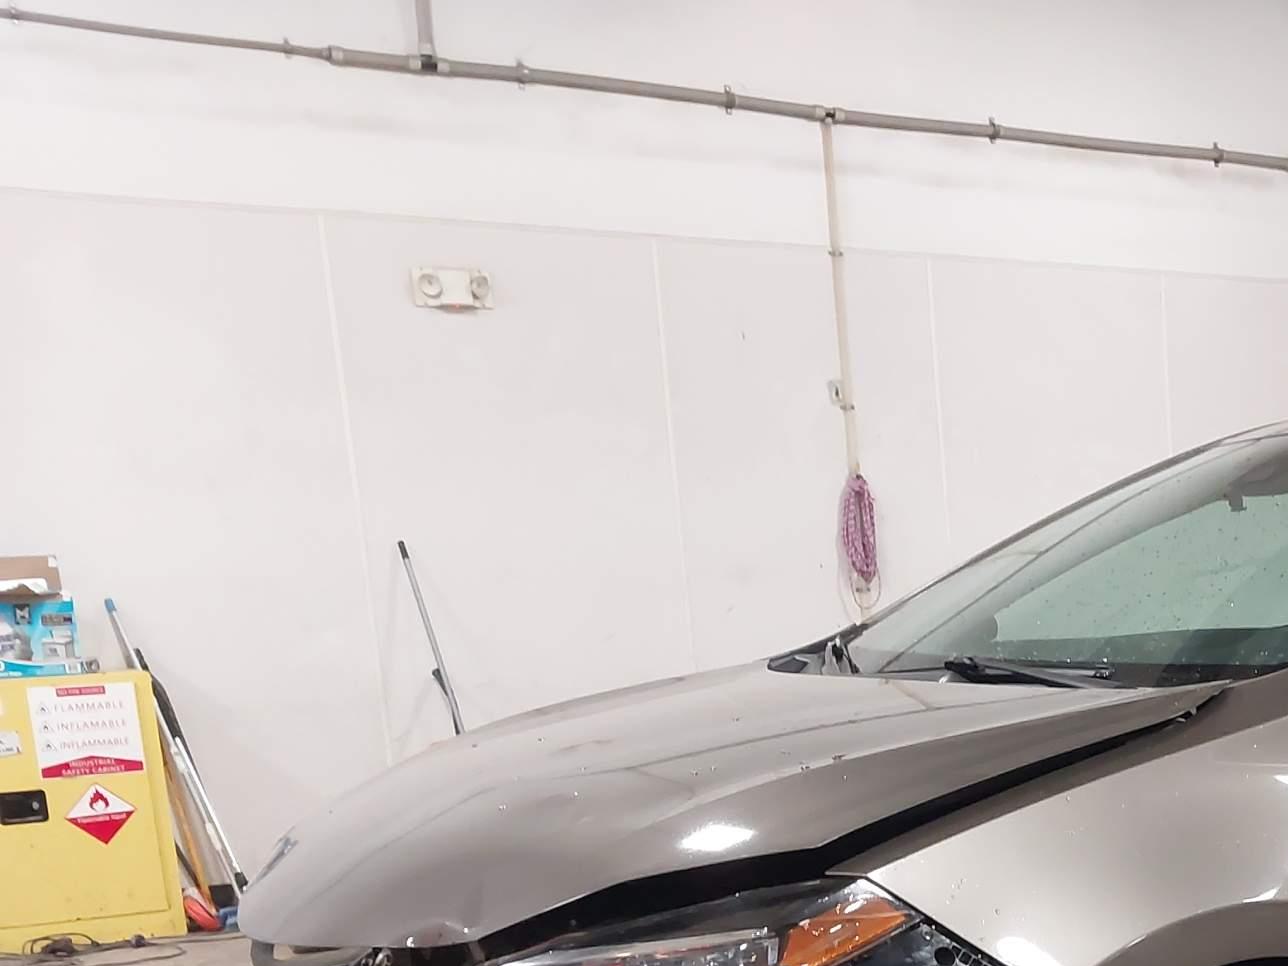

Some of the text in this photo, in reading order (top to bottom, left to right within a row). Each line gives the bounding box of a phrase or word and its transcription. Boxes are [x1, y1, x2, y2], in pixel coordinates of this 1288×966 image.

[54, 701, 123, 712] FLAMMABLE
[57, 719, 127, 731] INFLAMABLE
[60, 737, 129, 750] INFLAMMABLE
[62, 764, 126, 775] SAFETY CABINET
